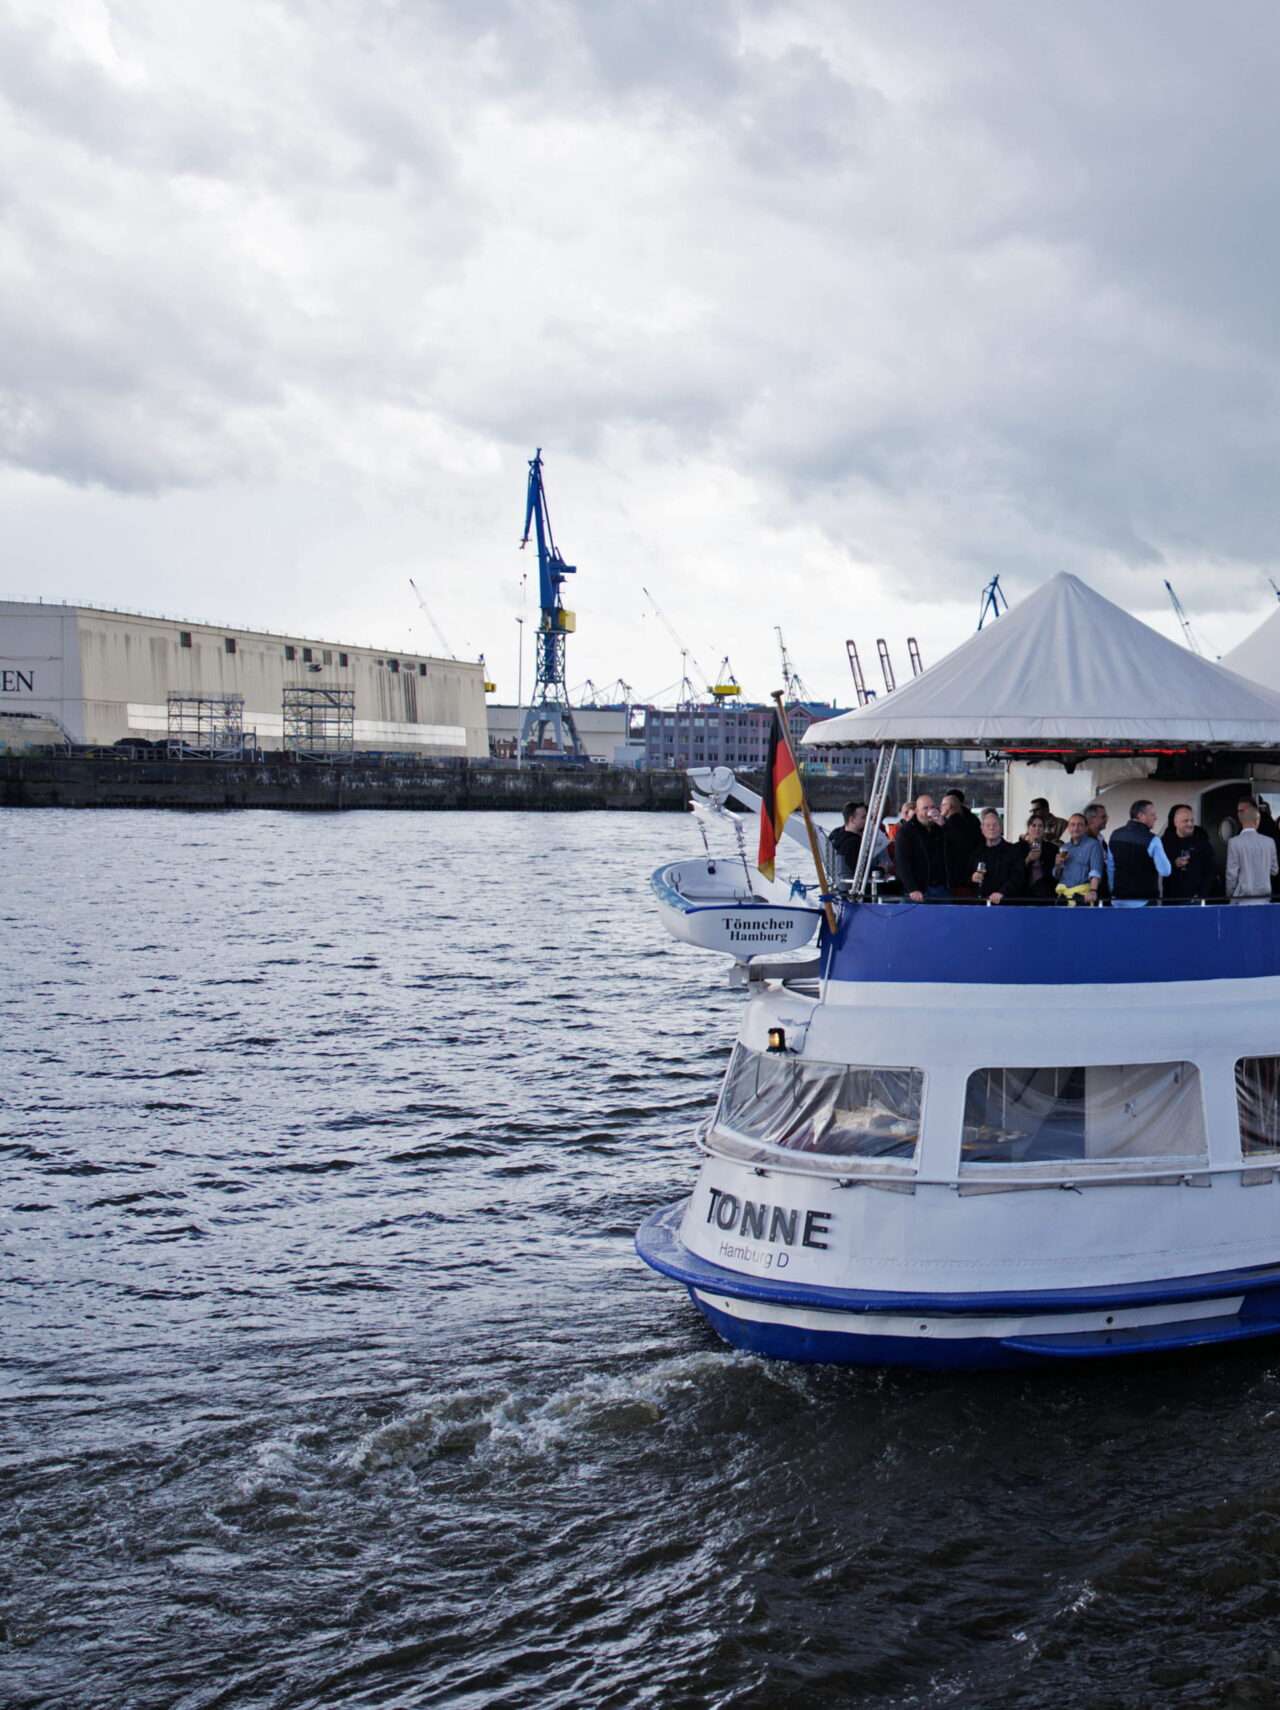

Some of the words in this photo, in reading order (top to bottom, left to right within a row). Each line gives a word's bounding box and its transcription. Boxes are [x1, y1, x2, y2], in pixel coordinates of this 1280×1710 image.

[1, 670, 35, 692] EN
[722, 917, 794, 930] Tönnchen
[730, 930, 788, 943] Hamburg
[706, 1186, 832, 1250] TONNE
[720, 1241, 773, 1269] Hamburg
[776, 1252, 790, 1268] D
